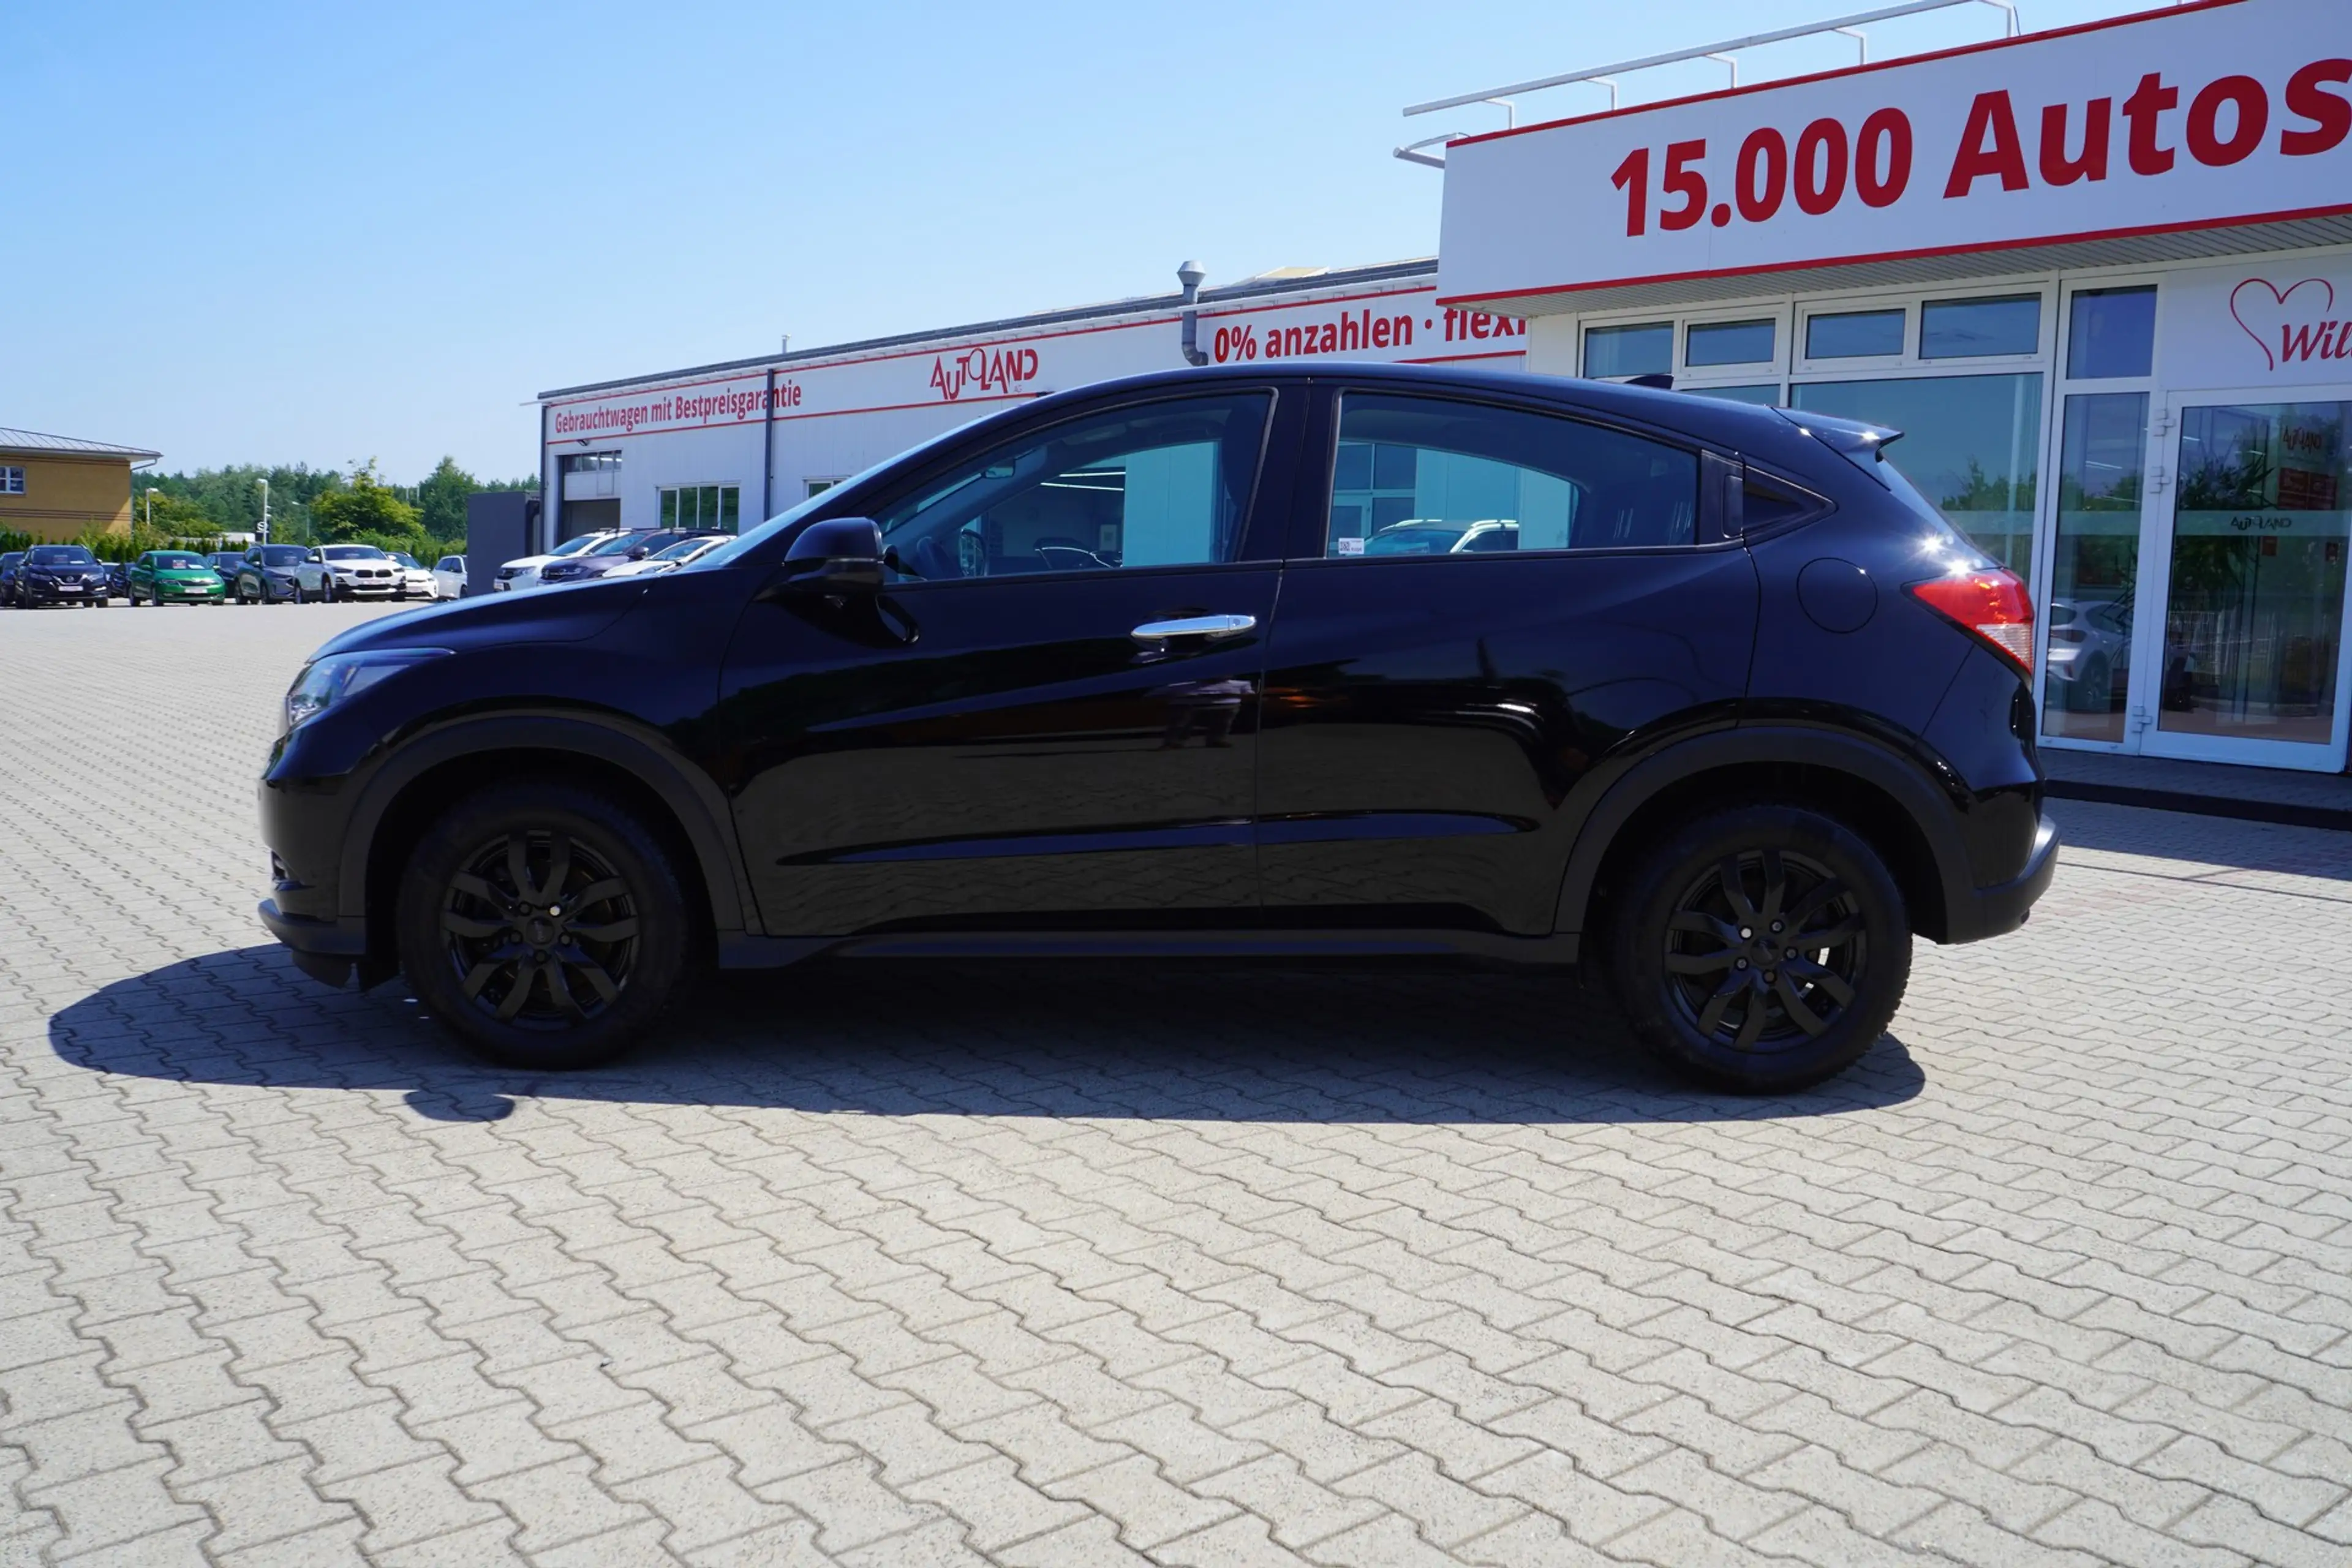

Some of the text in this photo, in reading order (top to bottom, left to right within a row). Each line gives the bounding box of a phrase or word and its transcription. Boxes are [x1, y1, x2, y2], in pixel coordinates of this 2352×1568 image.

[1611, 59, 2352, 236] 15.000 Autos
[1214, 325, 1257, 363] 0%
[1265, 308, 1413, 358] anzahlen
[930, 347, 1038, 400] AUTOLAND
[555, 379, 802, 432] Gebrauchtwagen mit Bestpreisgarantie
